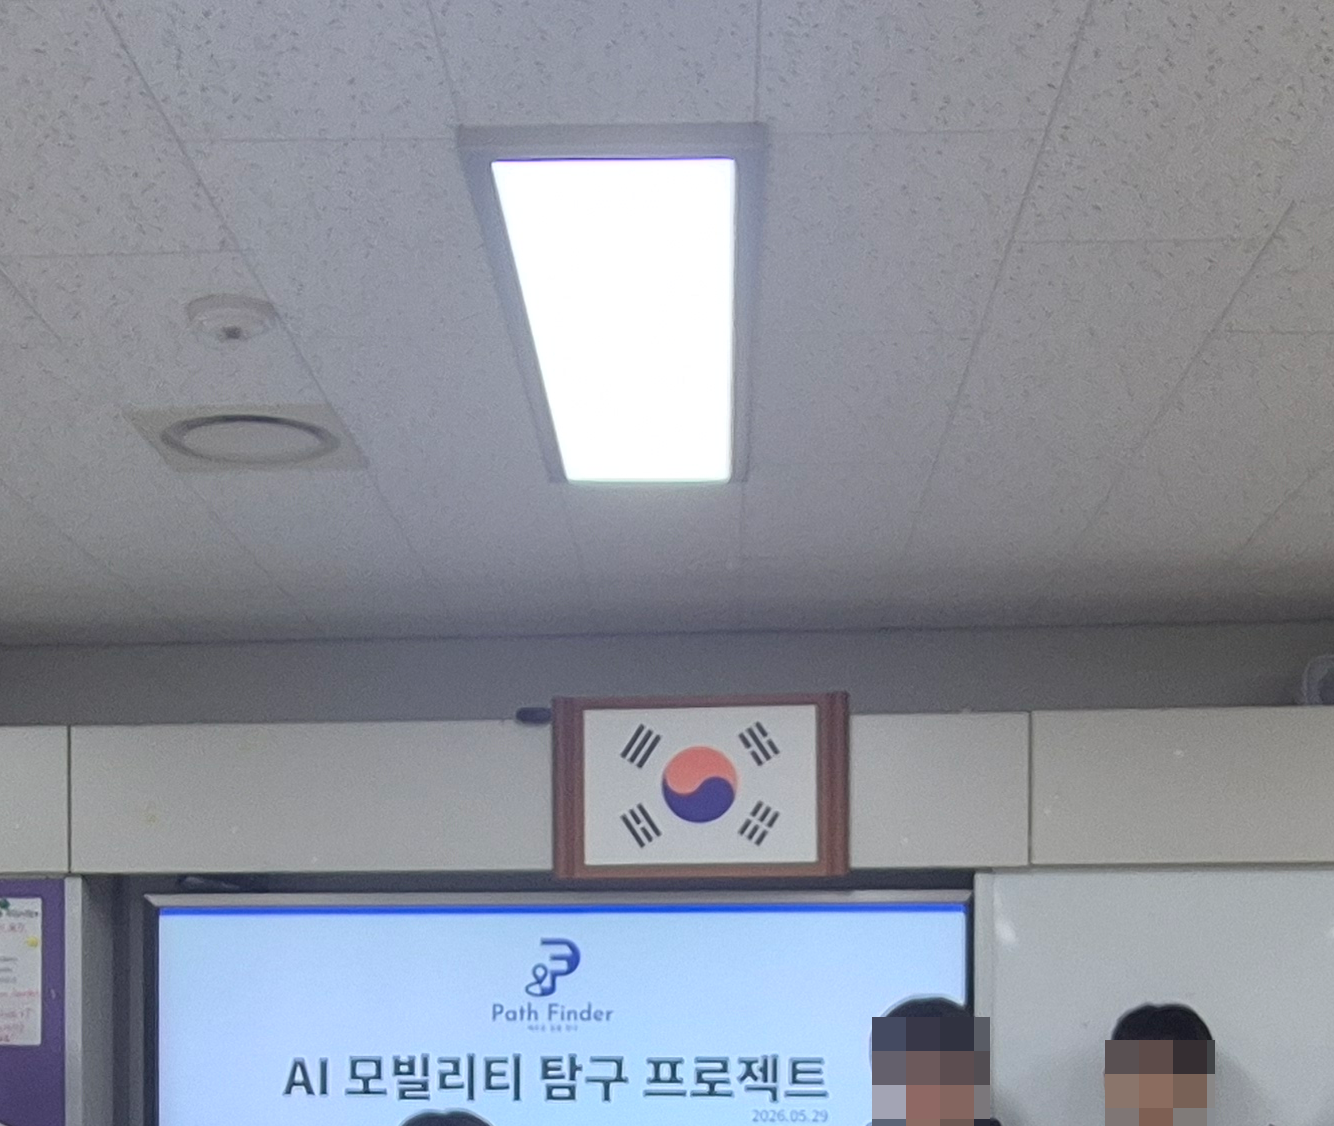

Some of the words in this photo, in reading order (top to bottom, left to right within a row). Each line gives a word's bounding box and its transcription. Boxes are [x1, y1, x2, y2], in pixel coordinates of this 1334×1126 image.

[492, 1002, 539, 1022] Path
[547, 1002, 614, 1022] Finder
[283, 1057, 328, 1096] AI
[345, 1053, 522, 1102] 모빌리티
[540, 1053, 629, 1102] 탐구
[643, 1053, 829, 1102] 프로젝트
[751, 1109, 829, 1123] 2026.05.29
